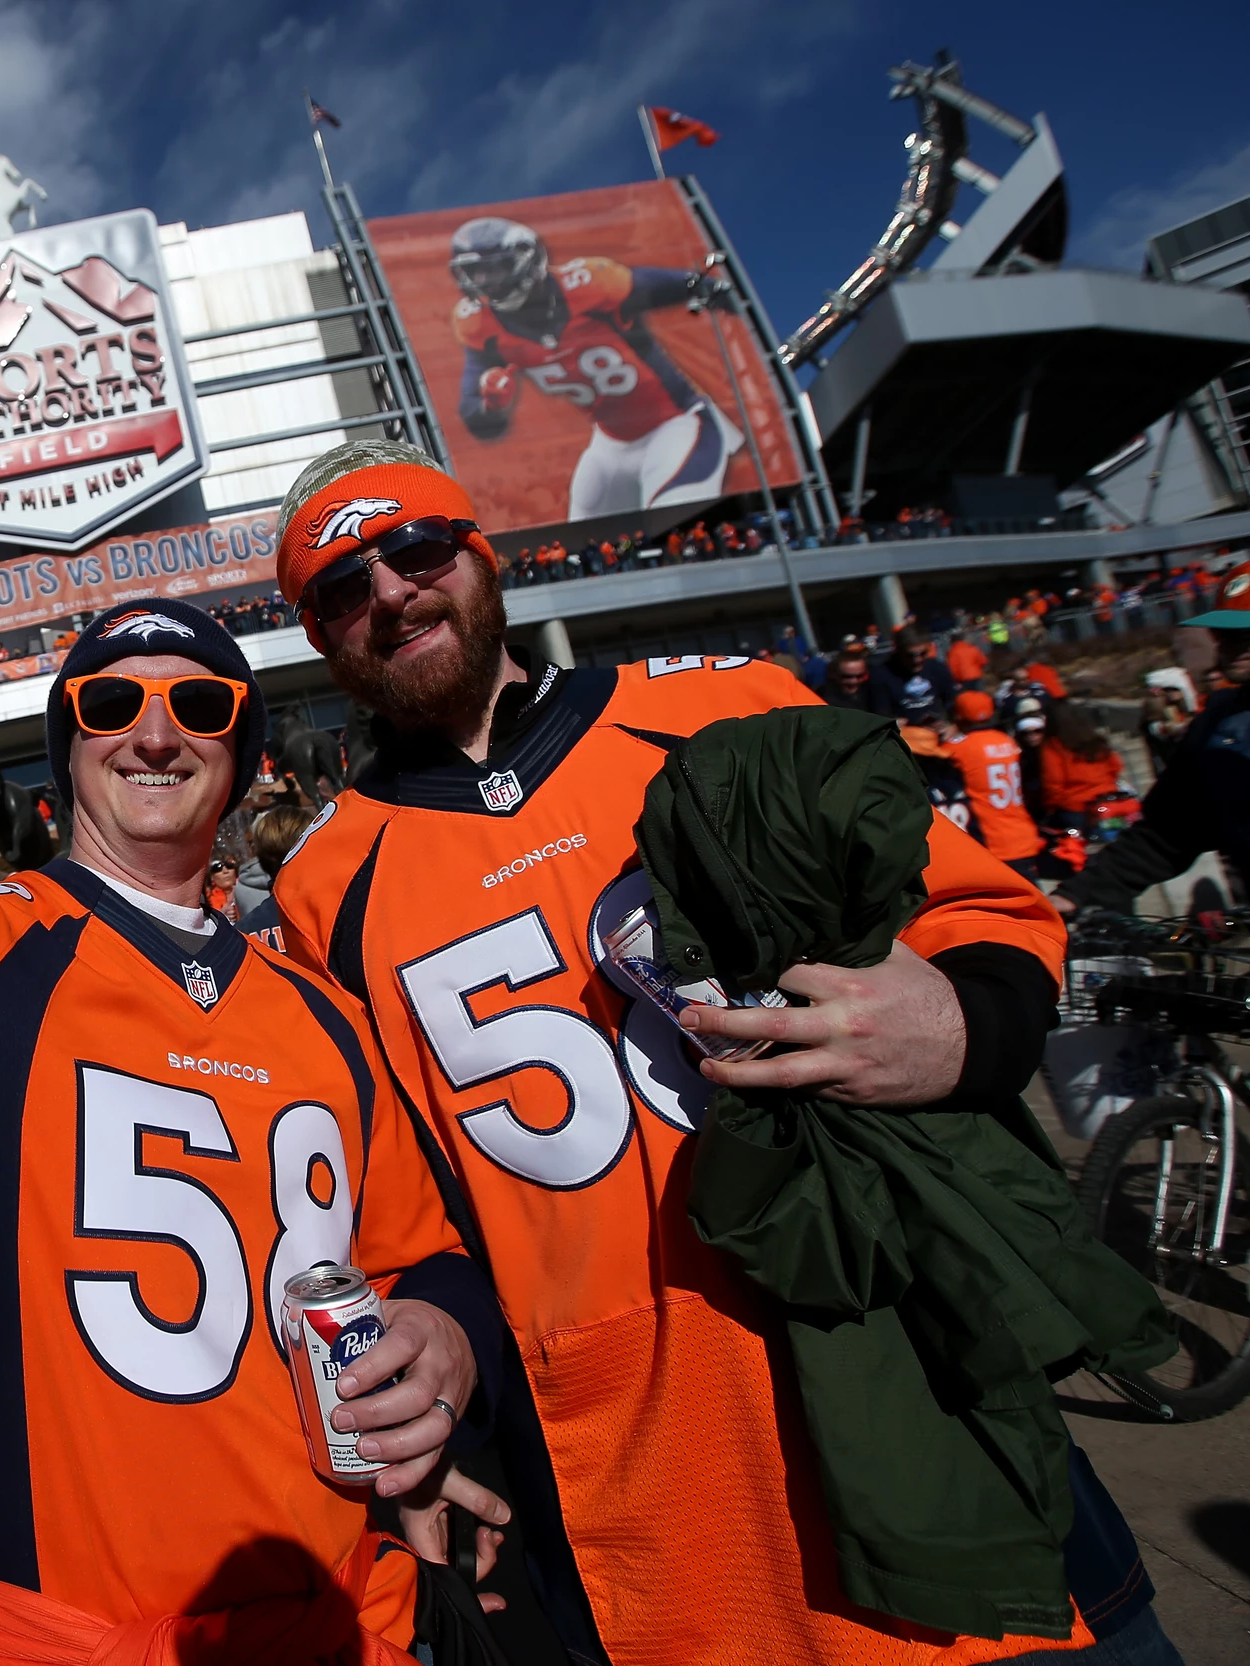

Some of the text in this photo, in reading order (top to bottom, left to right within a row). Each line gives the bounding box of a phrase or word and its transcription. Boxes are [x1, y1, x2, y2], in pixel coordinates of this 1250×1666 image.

[524, 346, 638, 406] 58
[0, 430, 109, 470] FIELD
[19, 483, 78, 511] MILE
[86, 459, 145, 498] HIGH
[107, 518, 277, 583] BRONCOS
[488, 784, 517, 806] NFL
[481, 832, 588, 890] BRONCOS
[190, 980, 214, 999] NFL
[167, 1052, 271, 1085] BRONCOS
[64, 1058, 352, 1404] 58
[340, 1326, 379, 1358] Pabst
[324, 1361, 346, 1380] Bl
